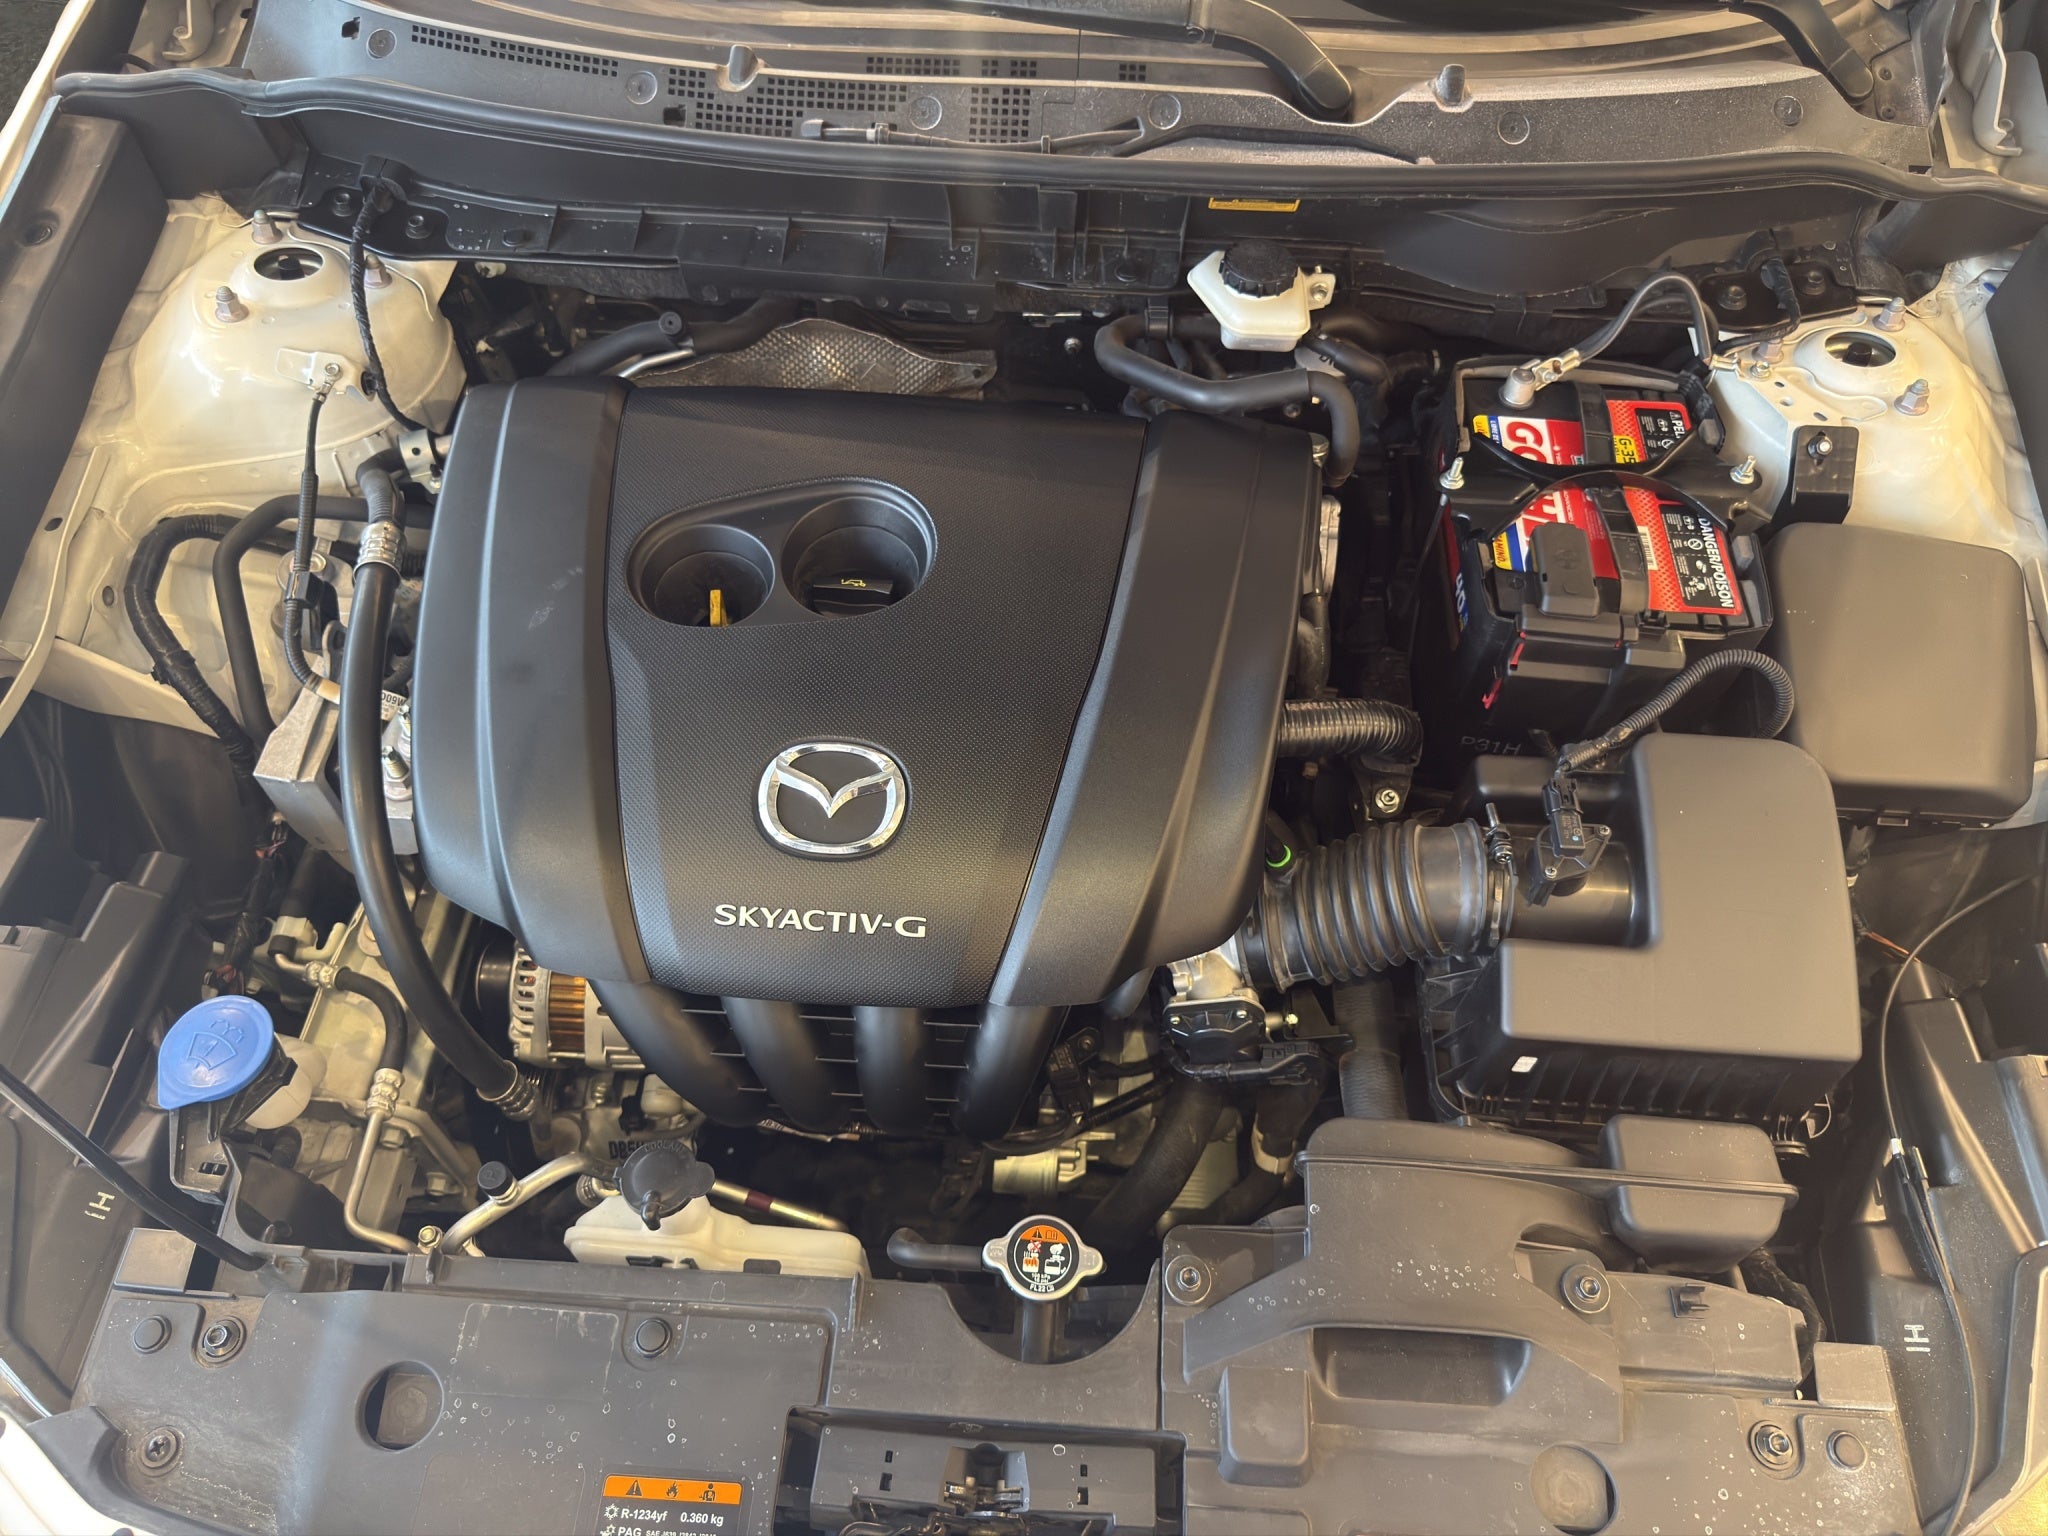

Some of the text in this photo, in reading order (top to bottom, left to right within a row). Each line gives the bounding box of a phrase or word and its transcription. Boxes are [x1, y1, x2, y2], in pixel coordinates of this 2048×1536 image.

[1670, 420, 1685, 439] PEL
[1697, 517, 1734, 608] DANGER/POISON
[713, 903, 928, 938] SKYACTIV-G
[620, 1508, 724, 1527] R-1234yf 0.360 kg
[618, 1526, 642, 1536] PAG
